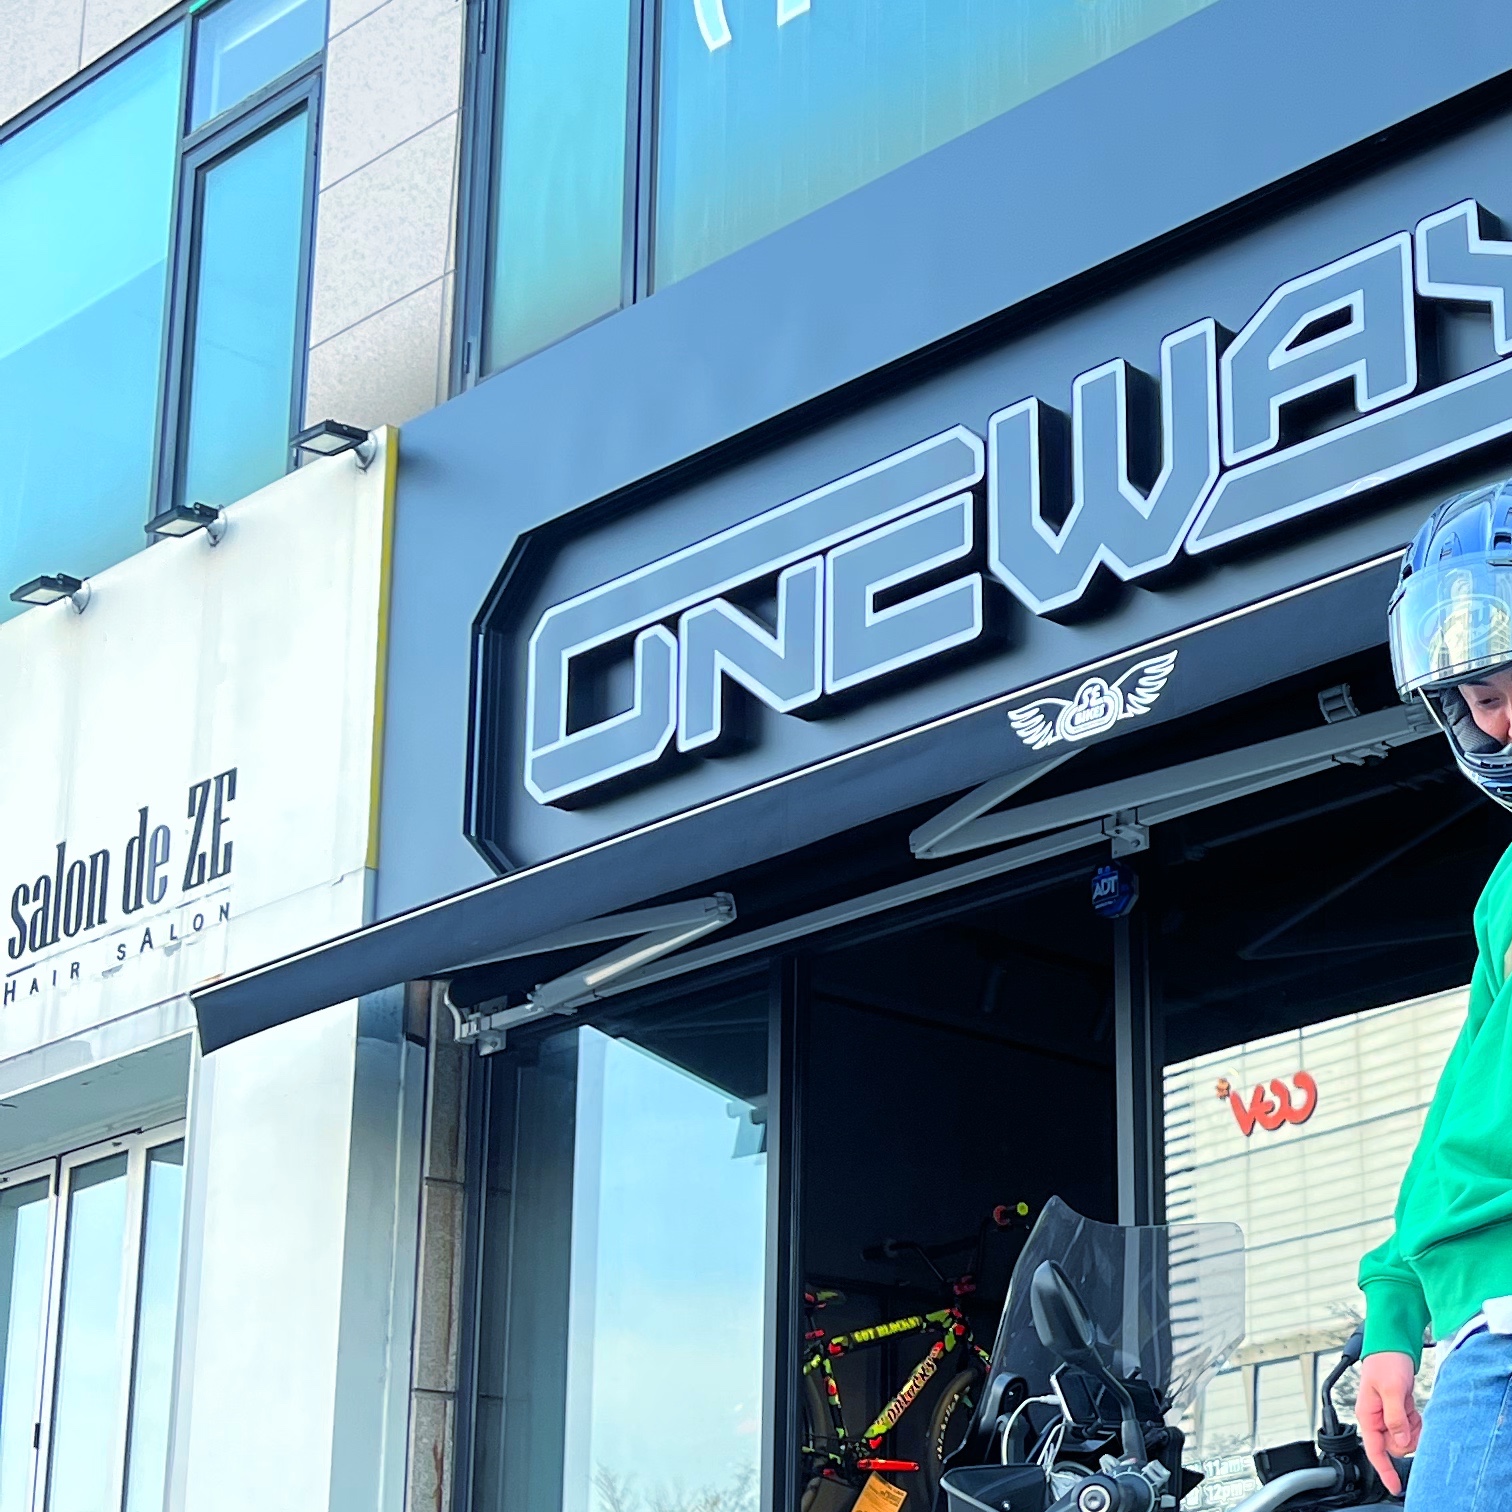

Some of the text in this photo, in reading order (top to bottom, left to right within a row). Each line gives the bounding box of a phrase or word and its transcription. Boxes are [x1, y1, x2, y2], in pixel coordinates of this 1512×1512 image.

[8, 767, 238, 959] salon de ZE
[1092, 875, 1119, 900] ADT
[4, 902, 230, 1008] HAIR SALON
